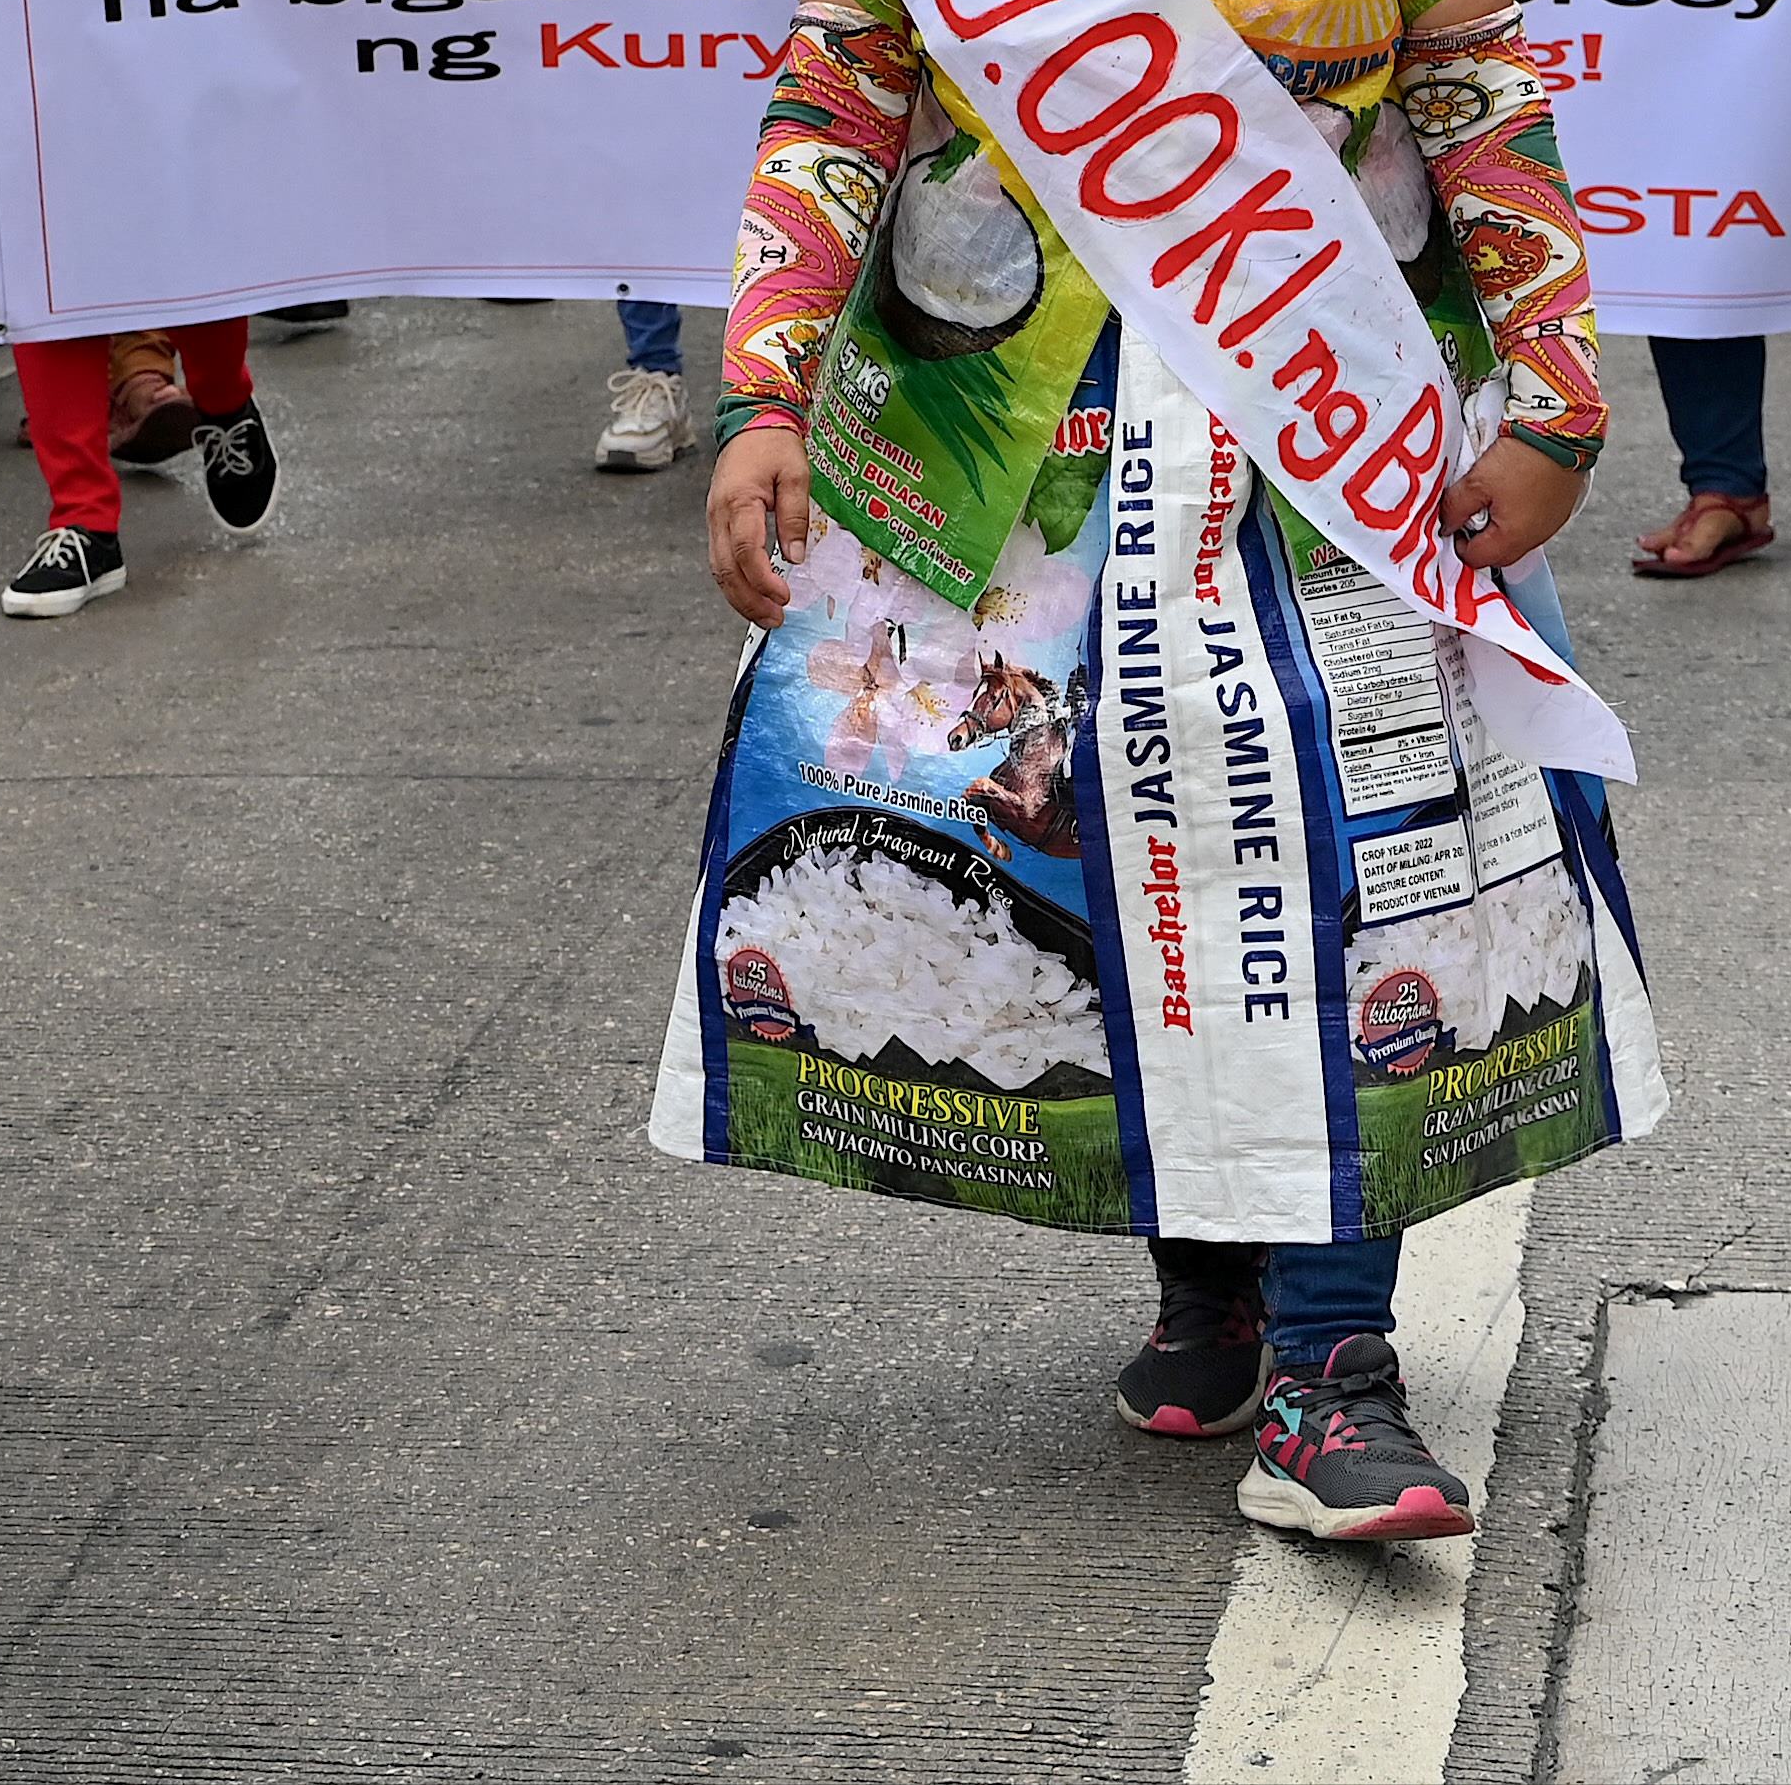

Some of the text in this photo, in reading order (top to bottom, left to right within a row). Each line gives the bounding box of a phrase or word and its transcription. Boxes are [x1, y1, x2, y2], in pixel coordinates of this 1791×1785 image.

[354, 22, 1604, 93] ng Kury g!
[1251, 48, 1391, 99] REMIUM
[1572, 185, 1787, 239] STA
[862, 357, 891, 406] KG
[841, 378, 882, 424] WEIGHT
[1273, 327, 1362, 483] ng
[847, 413, 925, 481] RICEMILL
[1046, 407, 1112, 456] lor
[862, 462, 948, 531] BULACAN
[889, 516, 975, 585] cup of water
[1300, 578, 1356, 597] Calories 205
[1334, 565, 1348, 577] Per
[1311, 614, 1332, 627] Total
[1333, 612, 1348, 623] Fat
[1367, 620, 1382, 631] Fat
[1382, 618, 1395, 630] 0g
[1323, 652, 1375, 668] Cholesterol
[1329, 637, 1371, 653] Trans Fat
[1328, 664, 1382, 680] Sodium 2mg
[1356, 674, 1408, 692] Carbohydrate
[1194, 407, 1291, 1025] Bachelor JASMINE RICE
[1346, 693, 1373, 707] Dietary
[1115, 418, 1194, 1037] Bachelor JASMINE RICE
[1338, 723, 1377, 738] Protein 4g
[1340, 733, 1445, 760] Vitamin Vitamin
[1343, 749, 1435, 775] Calcium Iron
[798, 761, 988, 827] 100% Pure Jasmine Rice
[782, 814, 1014, 911] Natural Fragrant Rice
[1386, 861, 1399, 874] OF
[1433, 849, 1452, 863] APR
[1414, 837, 1434, 852] 2022
[1409, 891, 1423, 905] OF
[1423, 882, 1461, 901] VIETNAM
[747, 960, 768, 982] 25
[1395, 979, 1419, 1005] 25
[1368, 1035, 1415, 1064] Premium
[1426, 1012, 1580, 1108] PROGRESSIVE
[797, 1050, 1039, 1135] PROGRESSIVE
[1422, 1100, 1476, 1140] GRAIN
[1474, 1075, 1536, 1118] MILLING
[797, 1089, 1050, 1164] GRAIN MILLING CORP.
[801, 1120, 1055, 1192] SAN JACINTO, PANGASINAN
[1421, 1144, 1452, 1170] SAN
